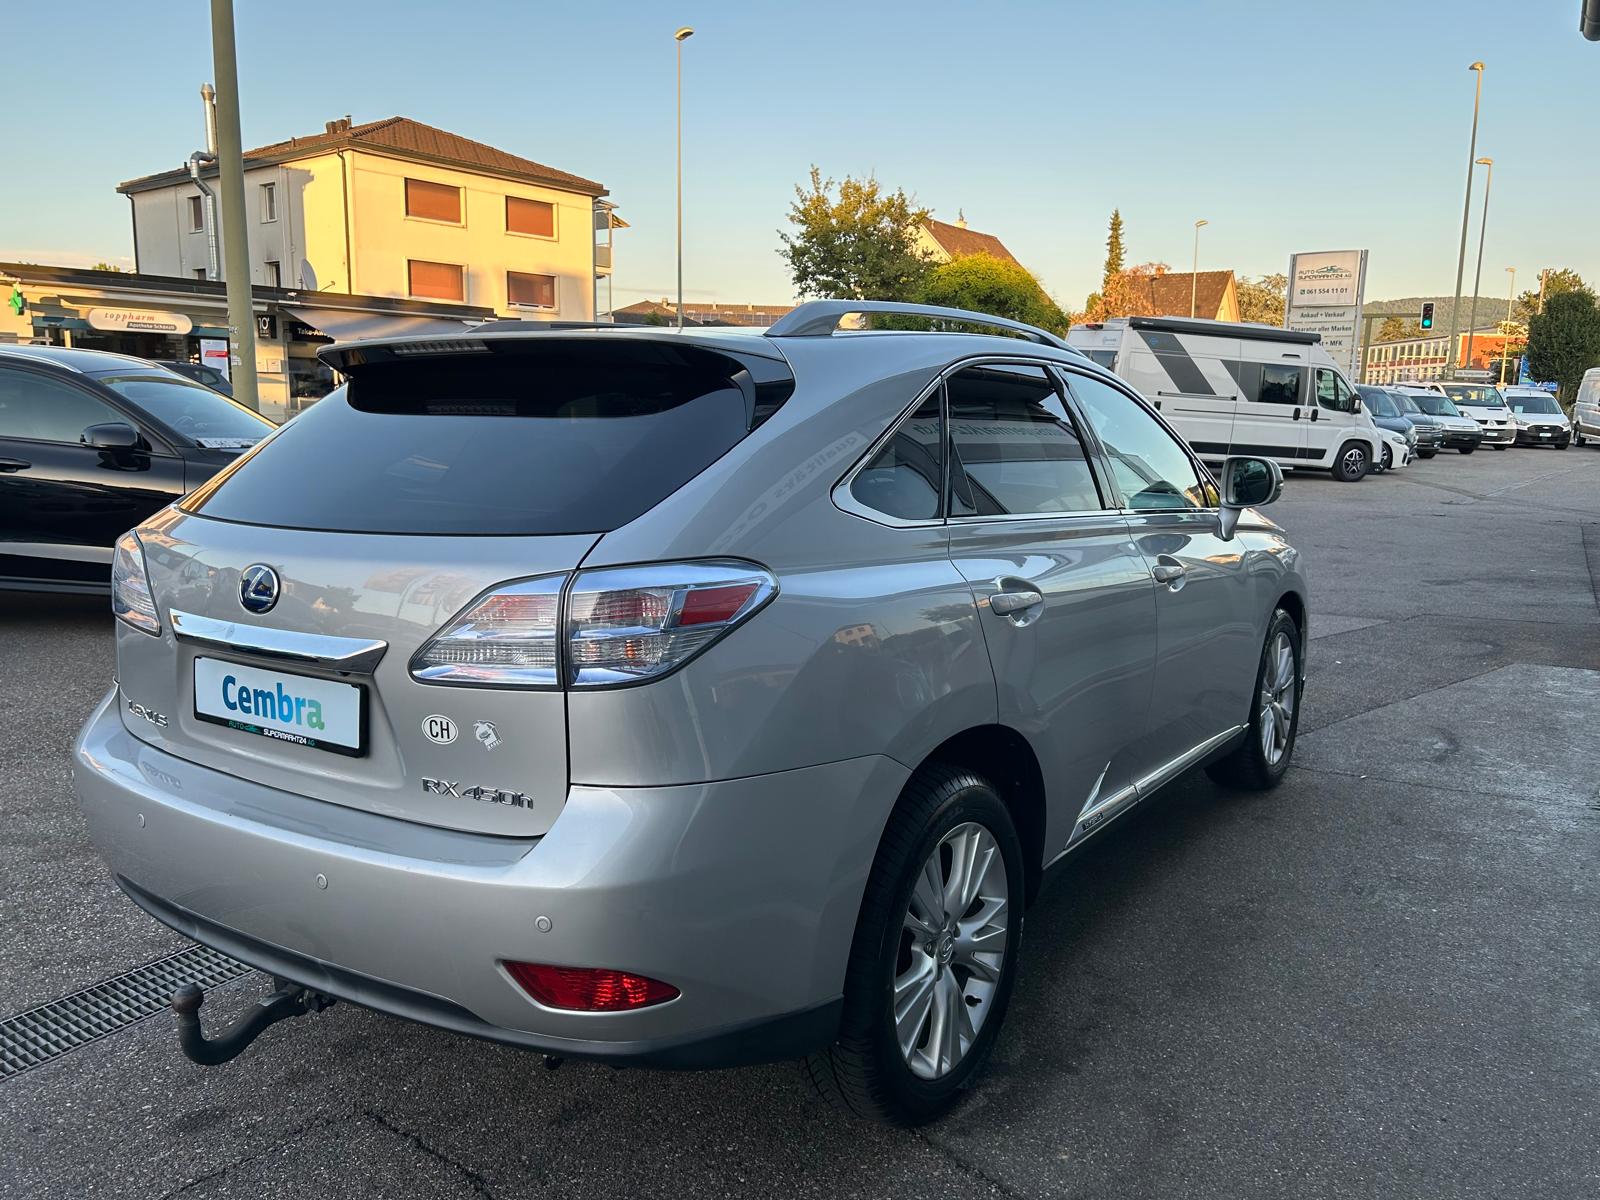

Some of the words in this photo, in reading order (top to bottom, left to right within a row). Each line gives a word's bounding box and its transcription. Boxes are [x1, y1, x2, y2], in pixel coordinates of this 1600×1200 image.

[104, 312, 155, 321] toppharm
[128, 700, 169, 728] LEXUS
[222, 675, 325, 731] Cembra
[228, 720, 244, 730] AUTO
[429, 719, 450, 740] CH
[421, 777, 461, 798] RX
[461, 785, 534, 810] 450h
